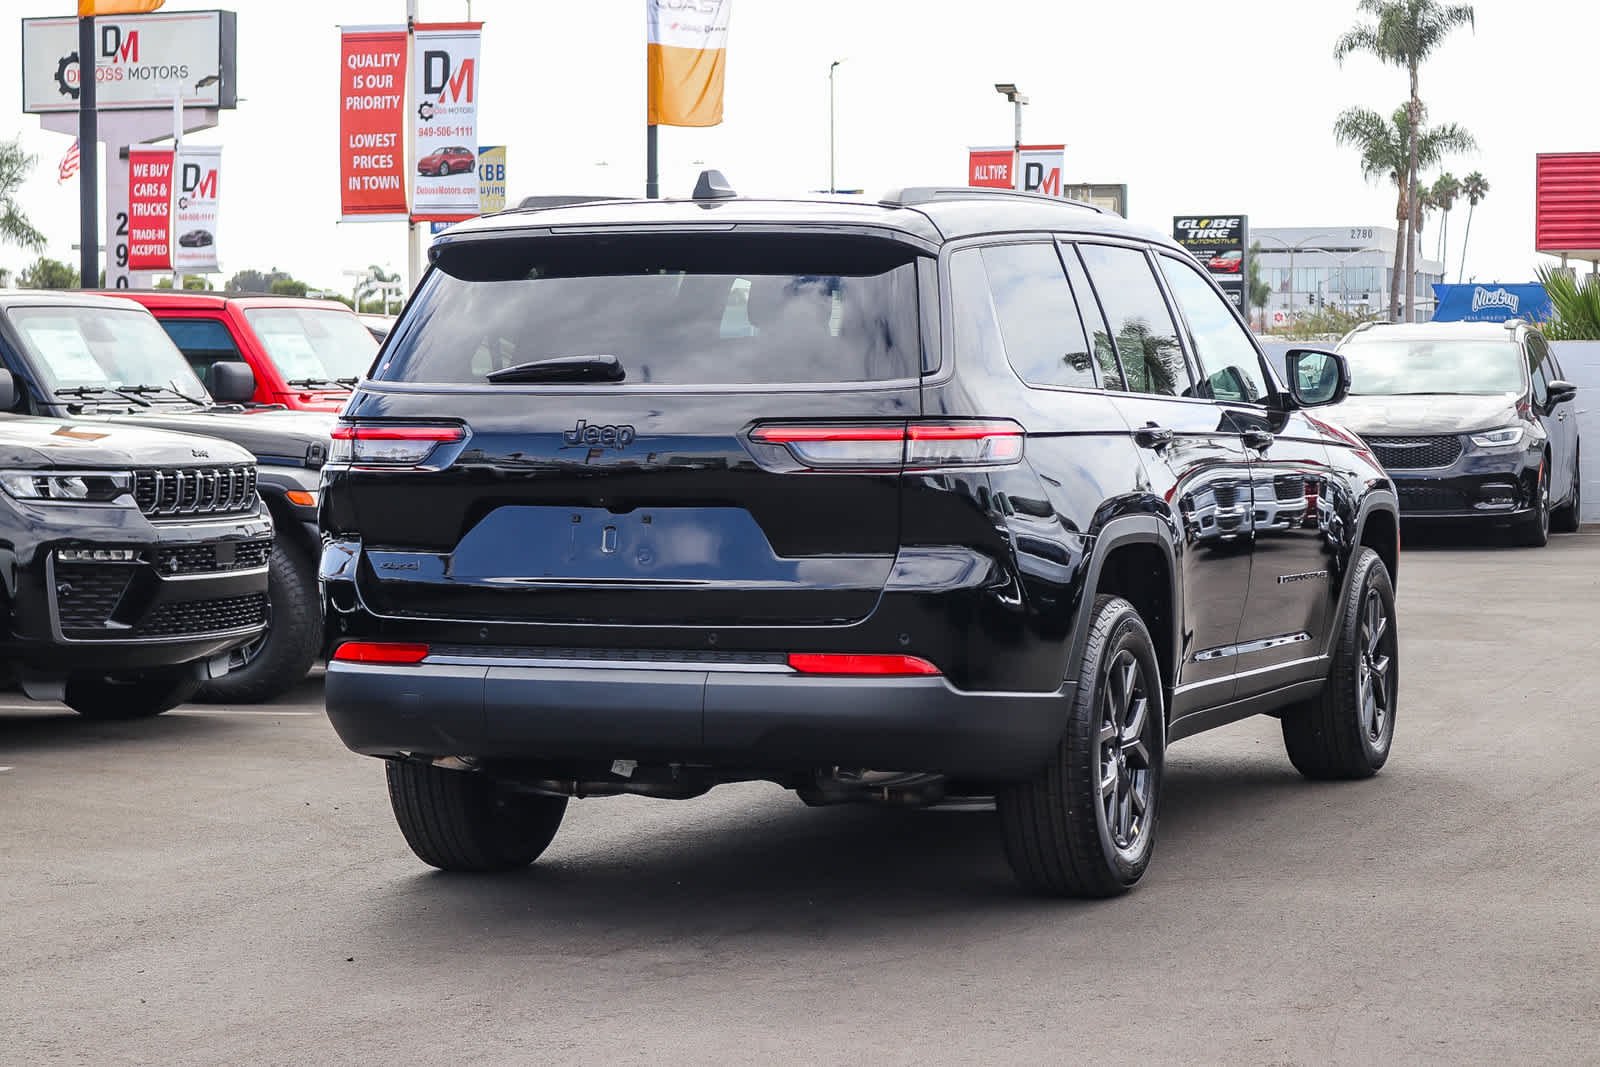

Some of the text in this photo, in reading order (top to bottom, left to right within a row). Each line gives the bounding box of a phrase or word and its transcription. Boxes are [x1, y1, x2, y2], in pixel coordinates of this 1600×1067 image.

[102, 25, 139, 63] DM
[348, 53, 401, 69] QUALITY
[67, 65, 189, 82] DOSS MOTORS
[424, 51, 475, 104] DM
[353, 74, 394, 89] IS OUR
[346, 95, 401, 110] PRIORITY
[349, 133, 397, 149] LOWEST
[353, 154, 394, 169] PRICES
[133, 163, 170, 177] WE BUY
[975, 164, 1008, 180] ALL TYPE
[182, 163, 217, 199] DM
[348, 175, 400, 191] IN TOWN
[1025, 162, 1061, 196] DM
[133, 183, 168, 198] CARS &
[480, 185, 505, 197] uying
[132, 202, 168, 217] TRUCKS
[1177, 218, 1240, 229] GLOBE
[132, 228, 167, 241] TRADE-IN
[1187, 229, 1230, 239] TIRE
[131, 244, 168, 256] ACCEPTED
[563, 419, 635, 450] Jeep
